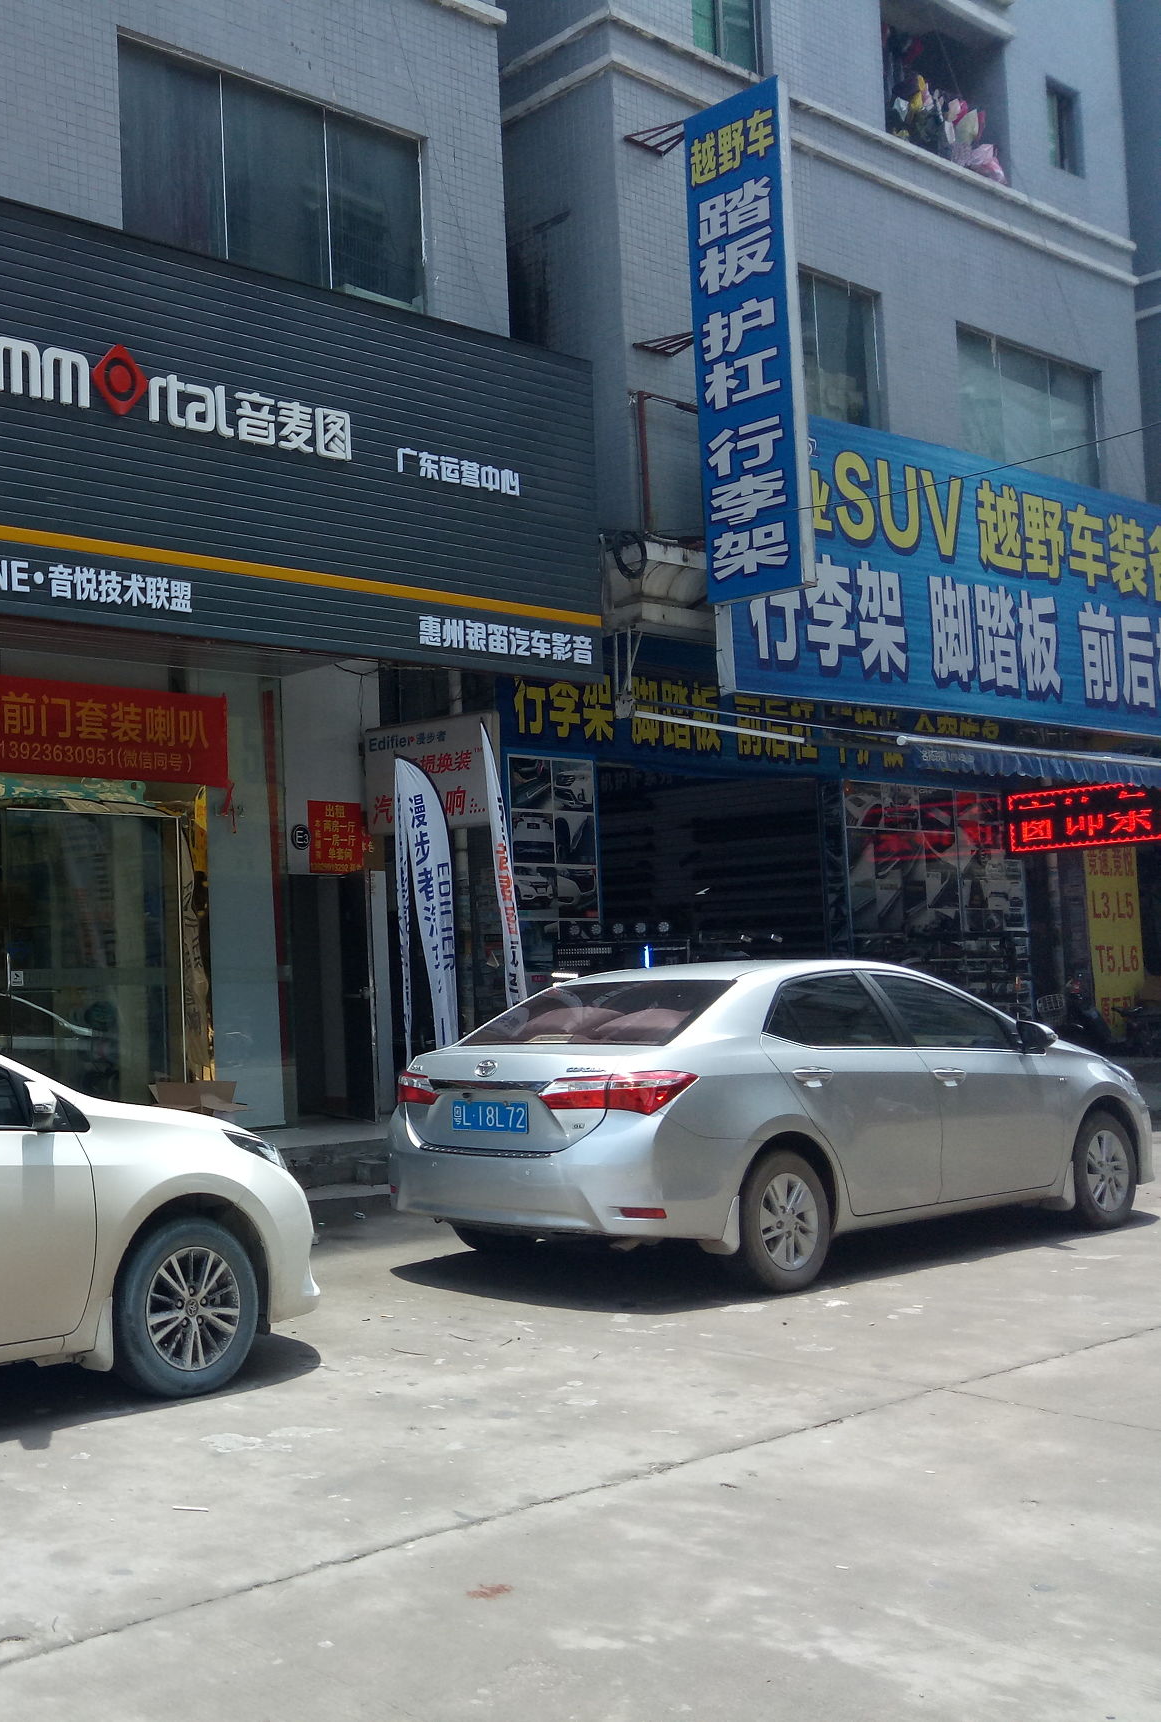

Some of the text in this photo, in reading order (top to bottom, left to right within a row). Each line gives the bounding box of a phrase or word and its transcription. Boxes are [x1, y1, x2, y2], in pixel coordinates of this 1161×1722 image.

[690, 107, 775, 188] 越野车
[697, 176, 789, 581] 踏板 护杠 行李架
[236, 391, 353, 463] 音麦图
[397, 447, 522, 498] 广东运营中心
[418, 616, 594, 666] 惠州银笛汽车影音
[750, 554, 1161, 709] 行李架 脚踏板 前后
[369, 733, 412, 752] Edifier
[410, 750, 472, 774] 损换装
[325, 804, 346, 818] 出租
